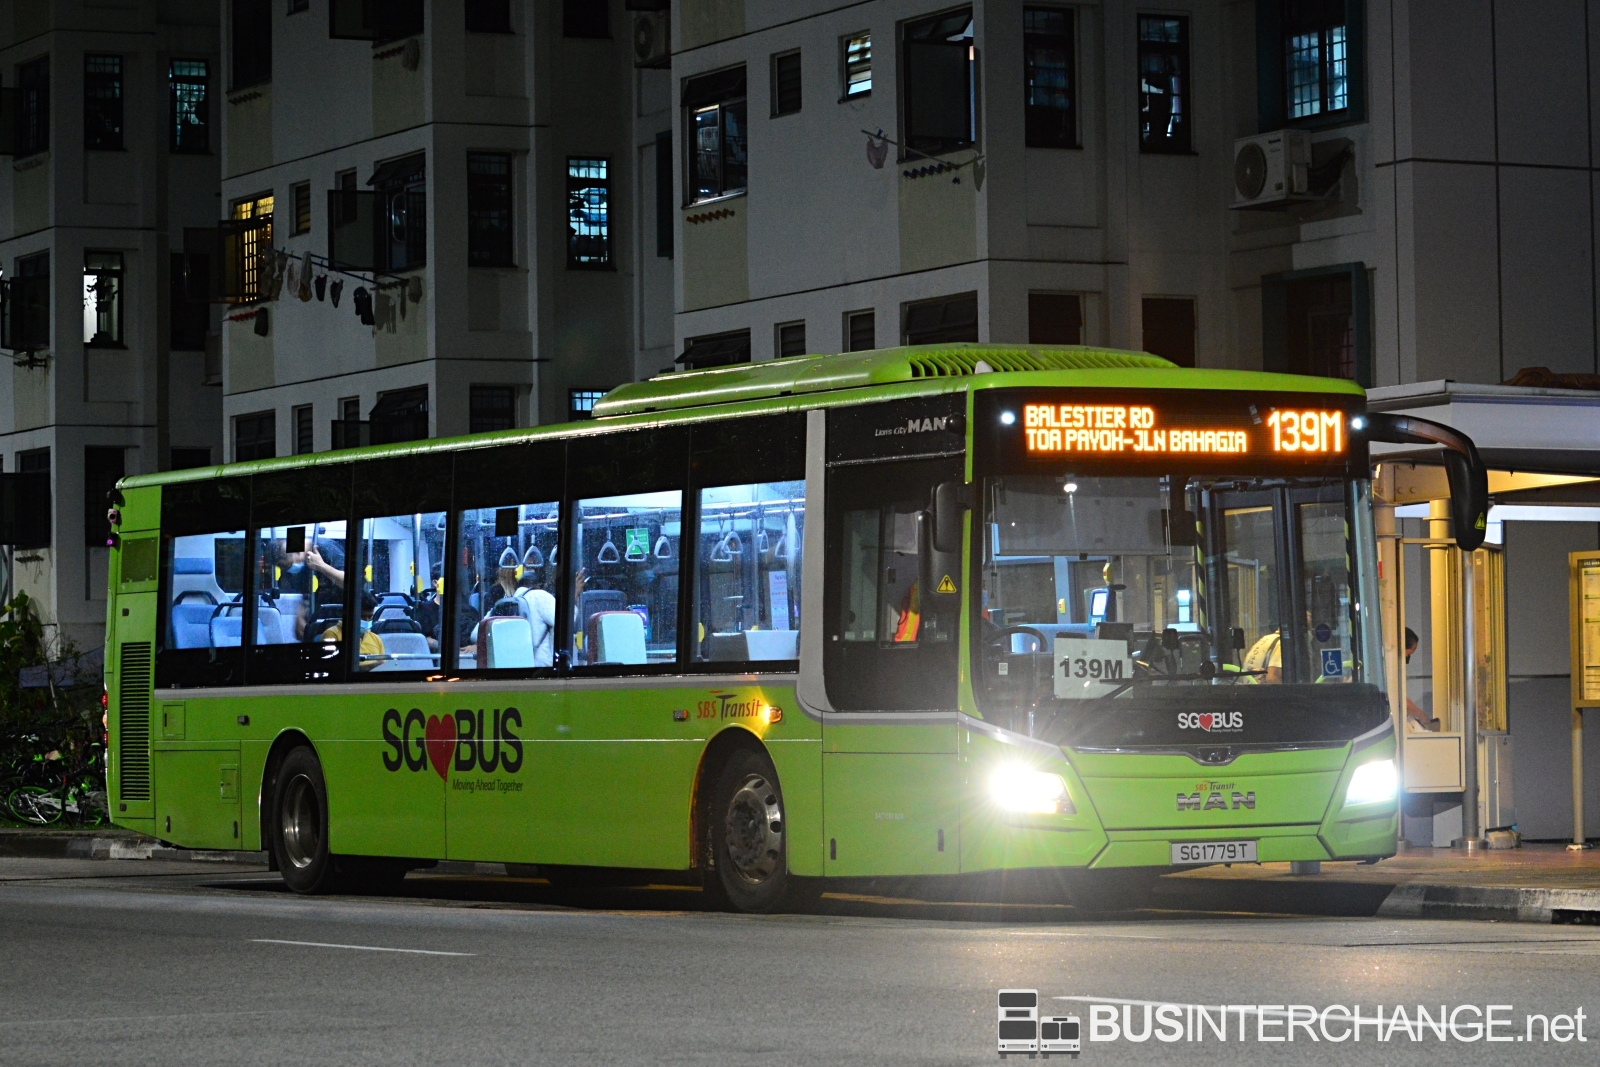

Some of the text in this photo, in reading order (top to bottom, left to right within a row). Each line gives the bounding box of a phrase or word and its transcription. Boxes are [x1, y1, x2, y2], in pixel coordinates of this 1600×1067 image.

[907, 416, 947, 434] MAN
[1025, 405, 1154, 428] BALESTIER RD
[1025, 429, 1247, 452] TOA PAYOH-JLN BAHAGIA
[1267, 410, 1342, 452] 139M
[1059, 658, 1123, 679] 139M
[697, 694, 763, 721] SBS Transit
[452, 778, 524, 794] Moving Ahead Together
[1195, 781, 1236, 792] SBS Transit
[1176, 791, 1256, 811] MAN
